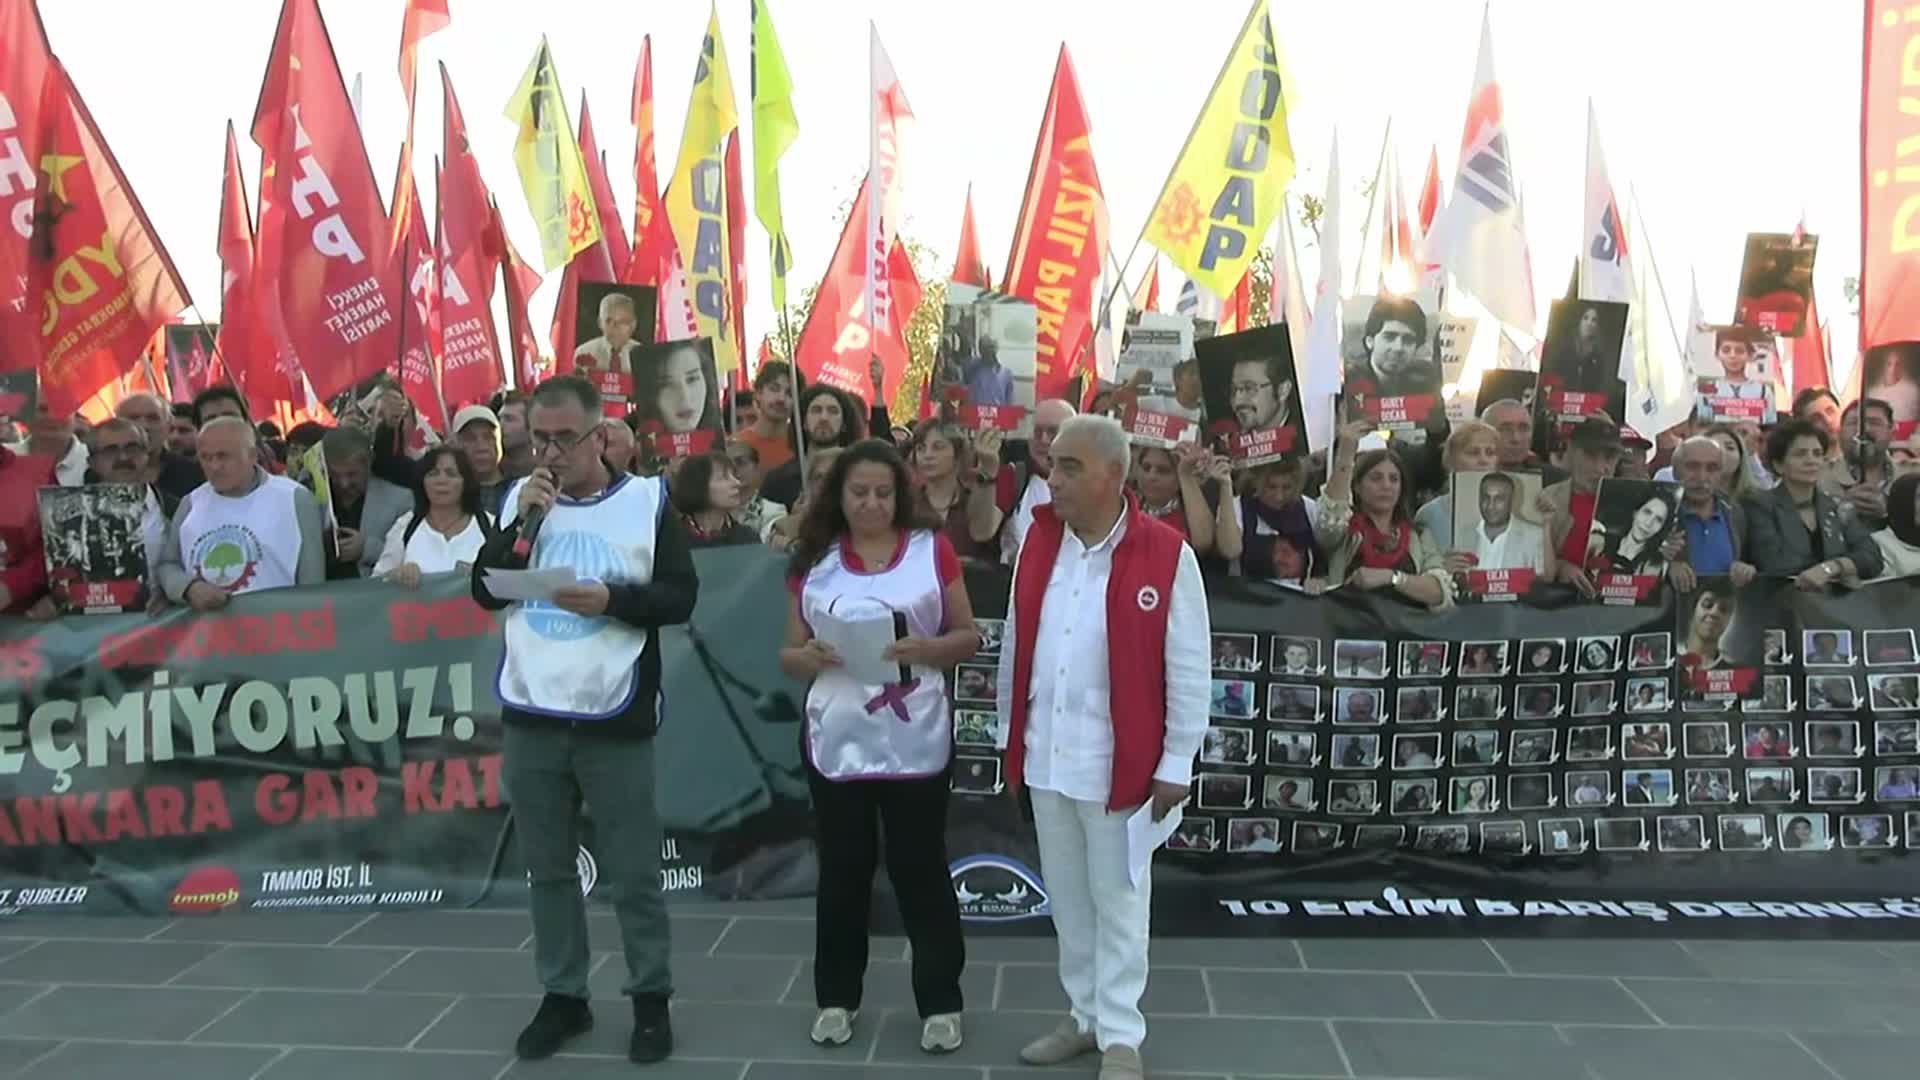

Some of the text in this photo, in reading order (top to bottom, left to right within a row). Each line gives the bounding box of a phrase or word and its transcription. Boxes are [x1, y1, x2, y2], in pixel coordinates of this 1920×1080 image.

[255, 765, 378, 825] GAR
[261, 868, 324, 892] TMMOB
[173, 887, 240, 905] tmmob
[1219, 899, 1291, 917] 10
[1302, 887, 1467, 917] EKİM
[1474, 898, 1669, 921] BARIŞ
